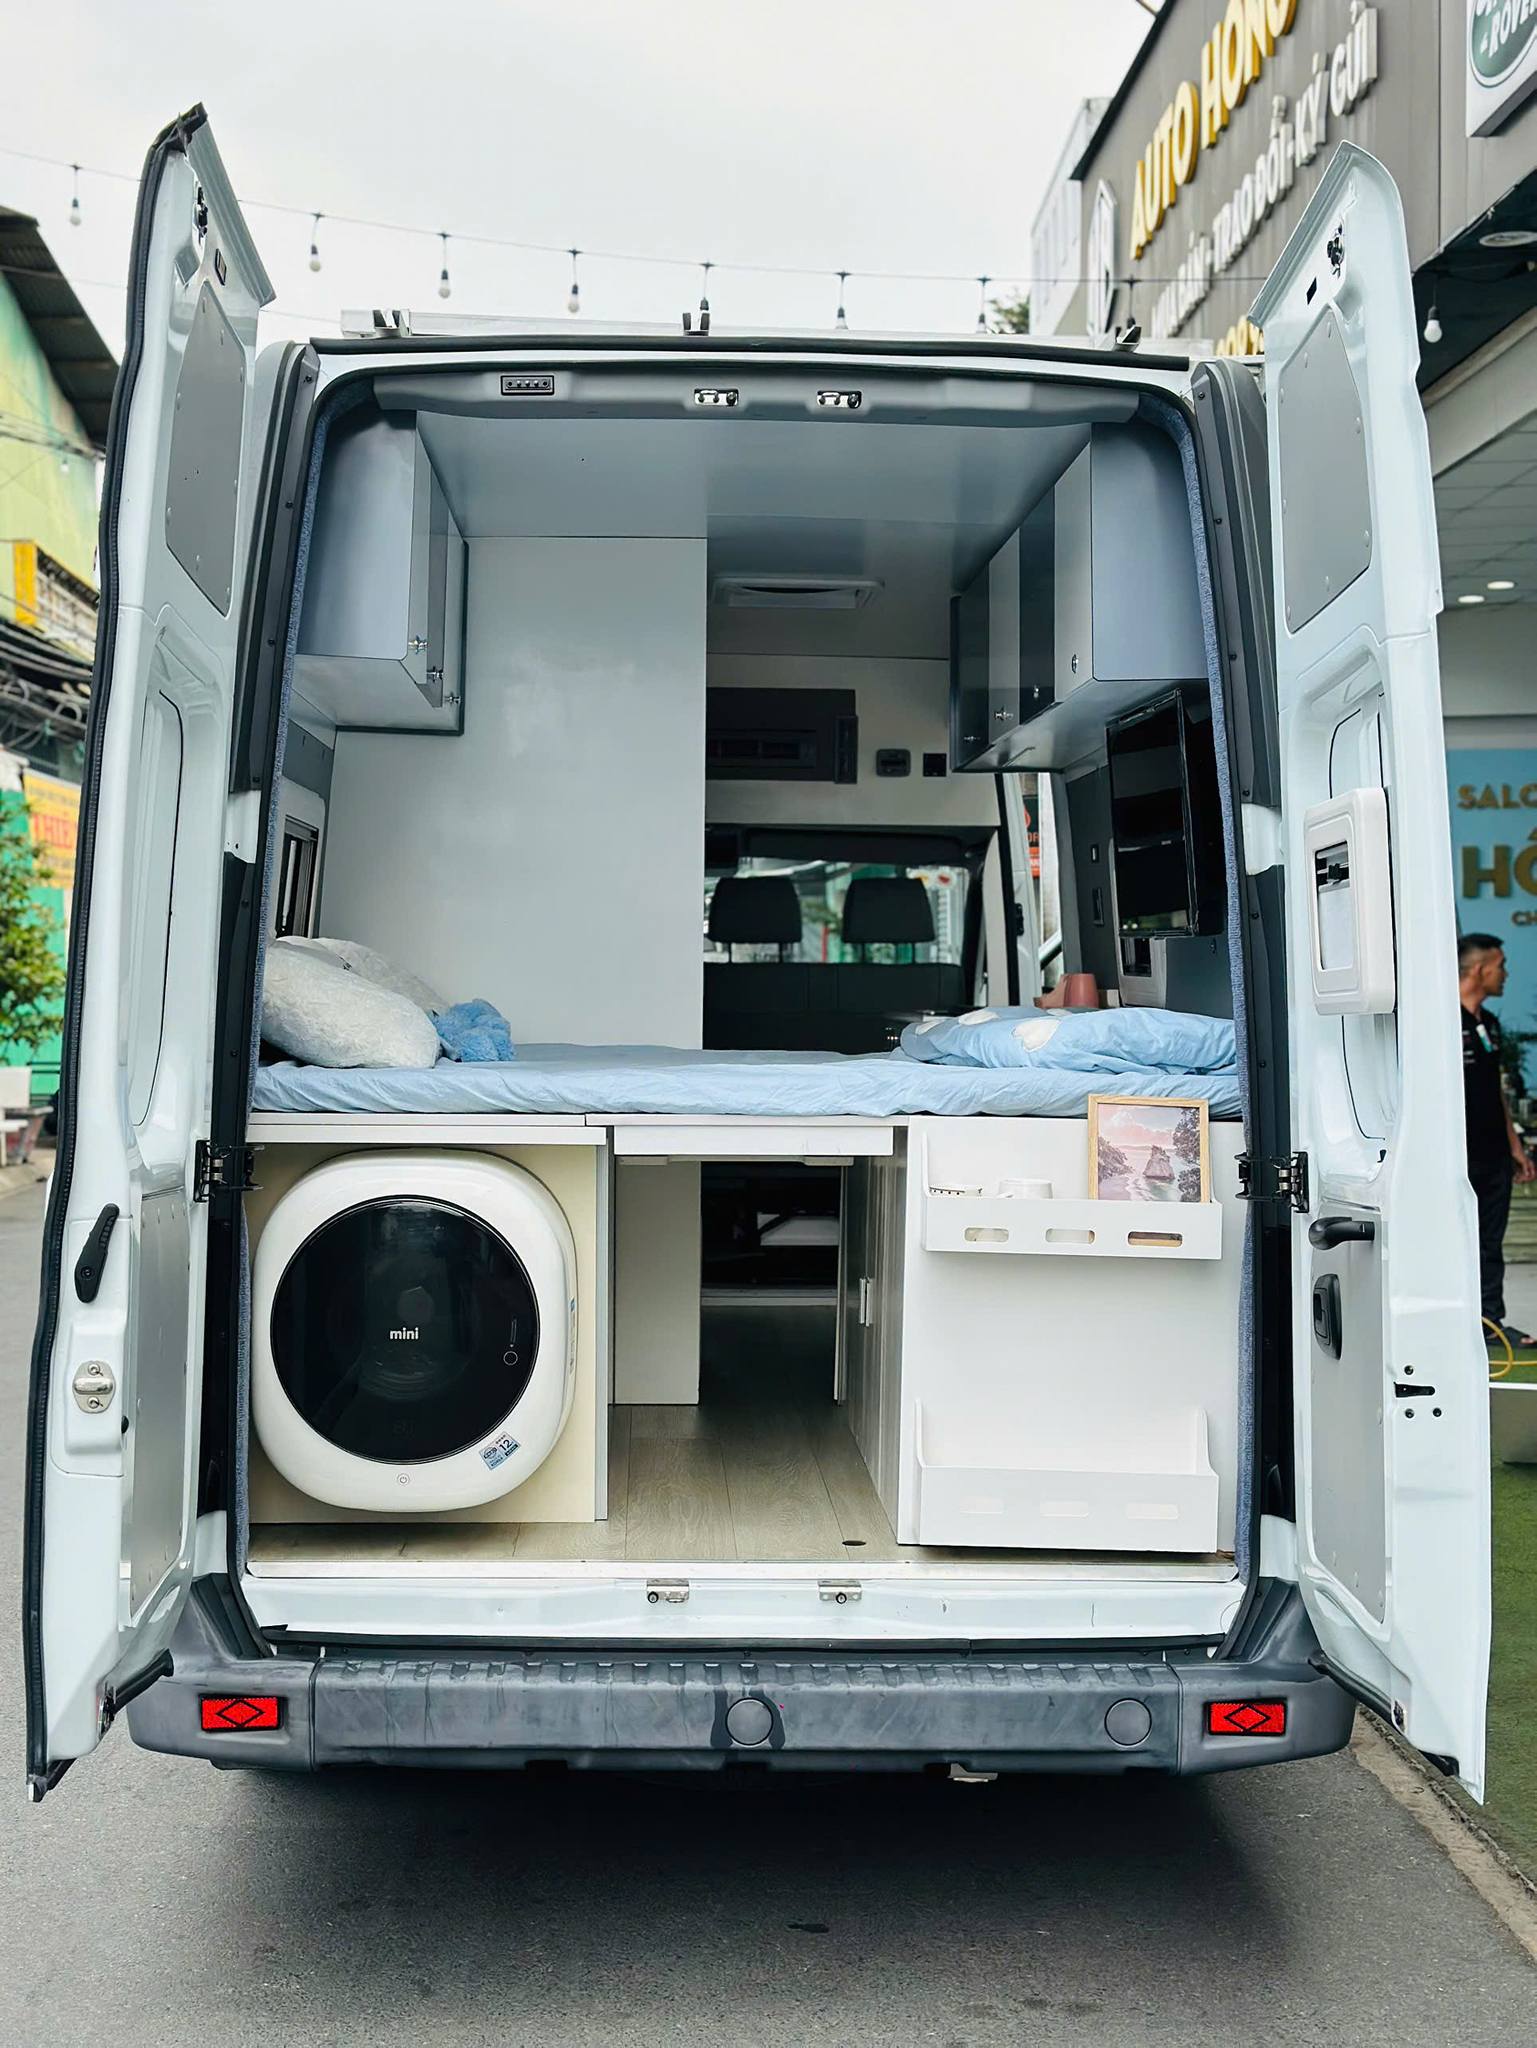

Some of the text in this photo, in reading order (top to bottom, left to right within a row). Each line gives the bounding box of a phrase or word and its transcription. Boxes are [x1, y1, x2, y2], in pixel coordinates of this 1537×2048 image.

[1131, 81, 1198, 260] AUTO
[389, 1327, 419, 1340] mini
[499, 1439, 512, 1451] 12
